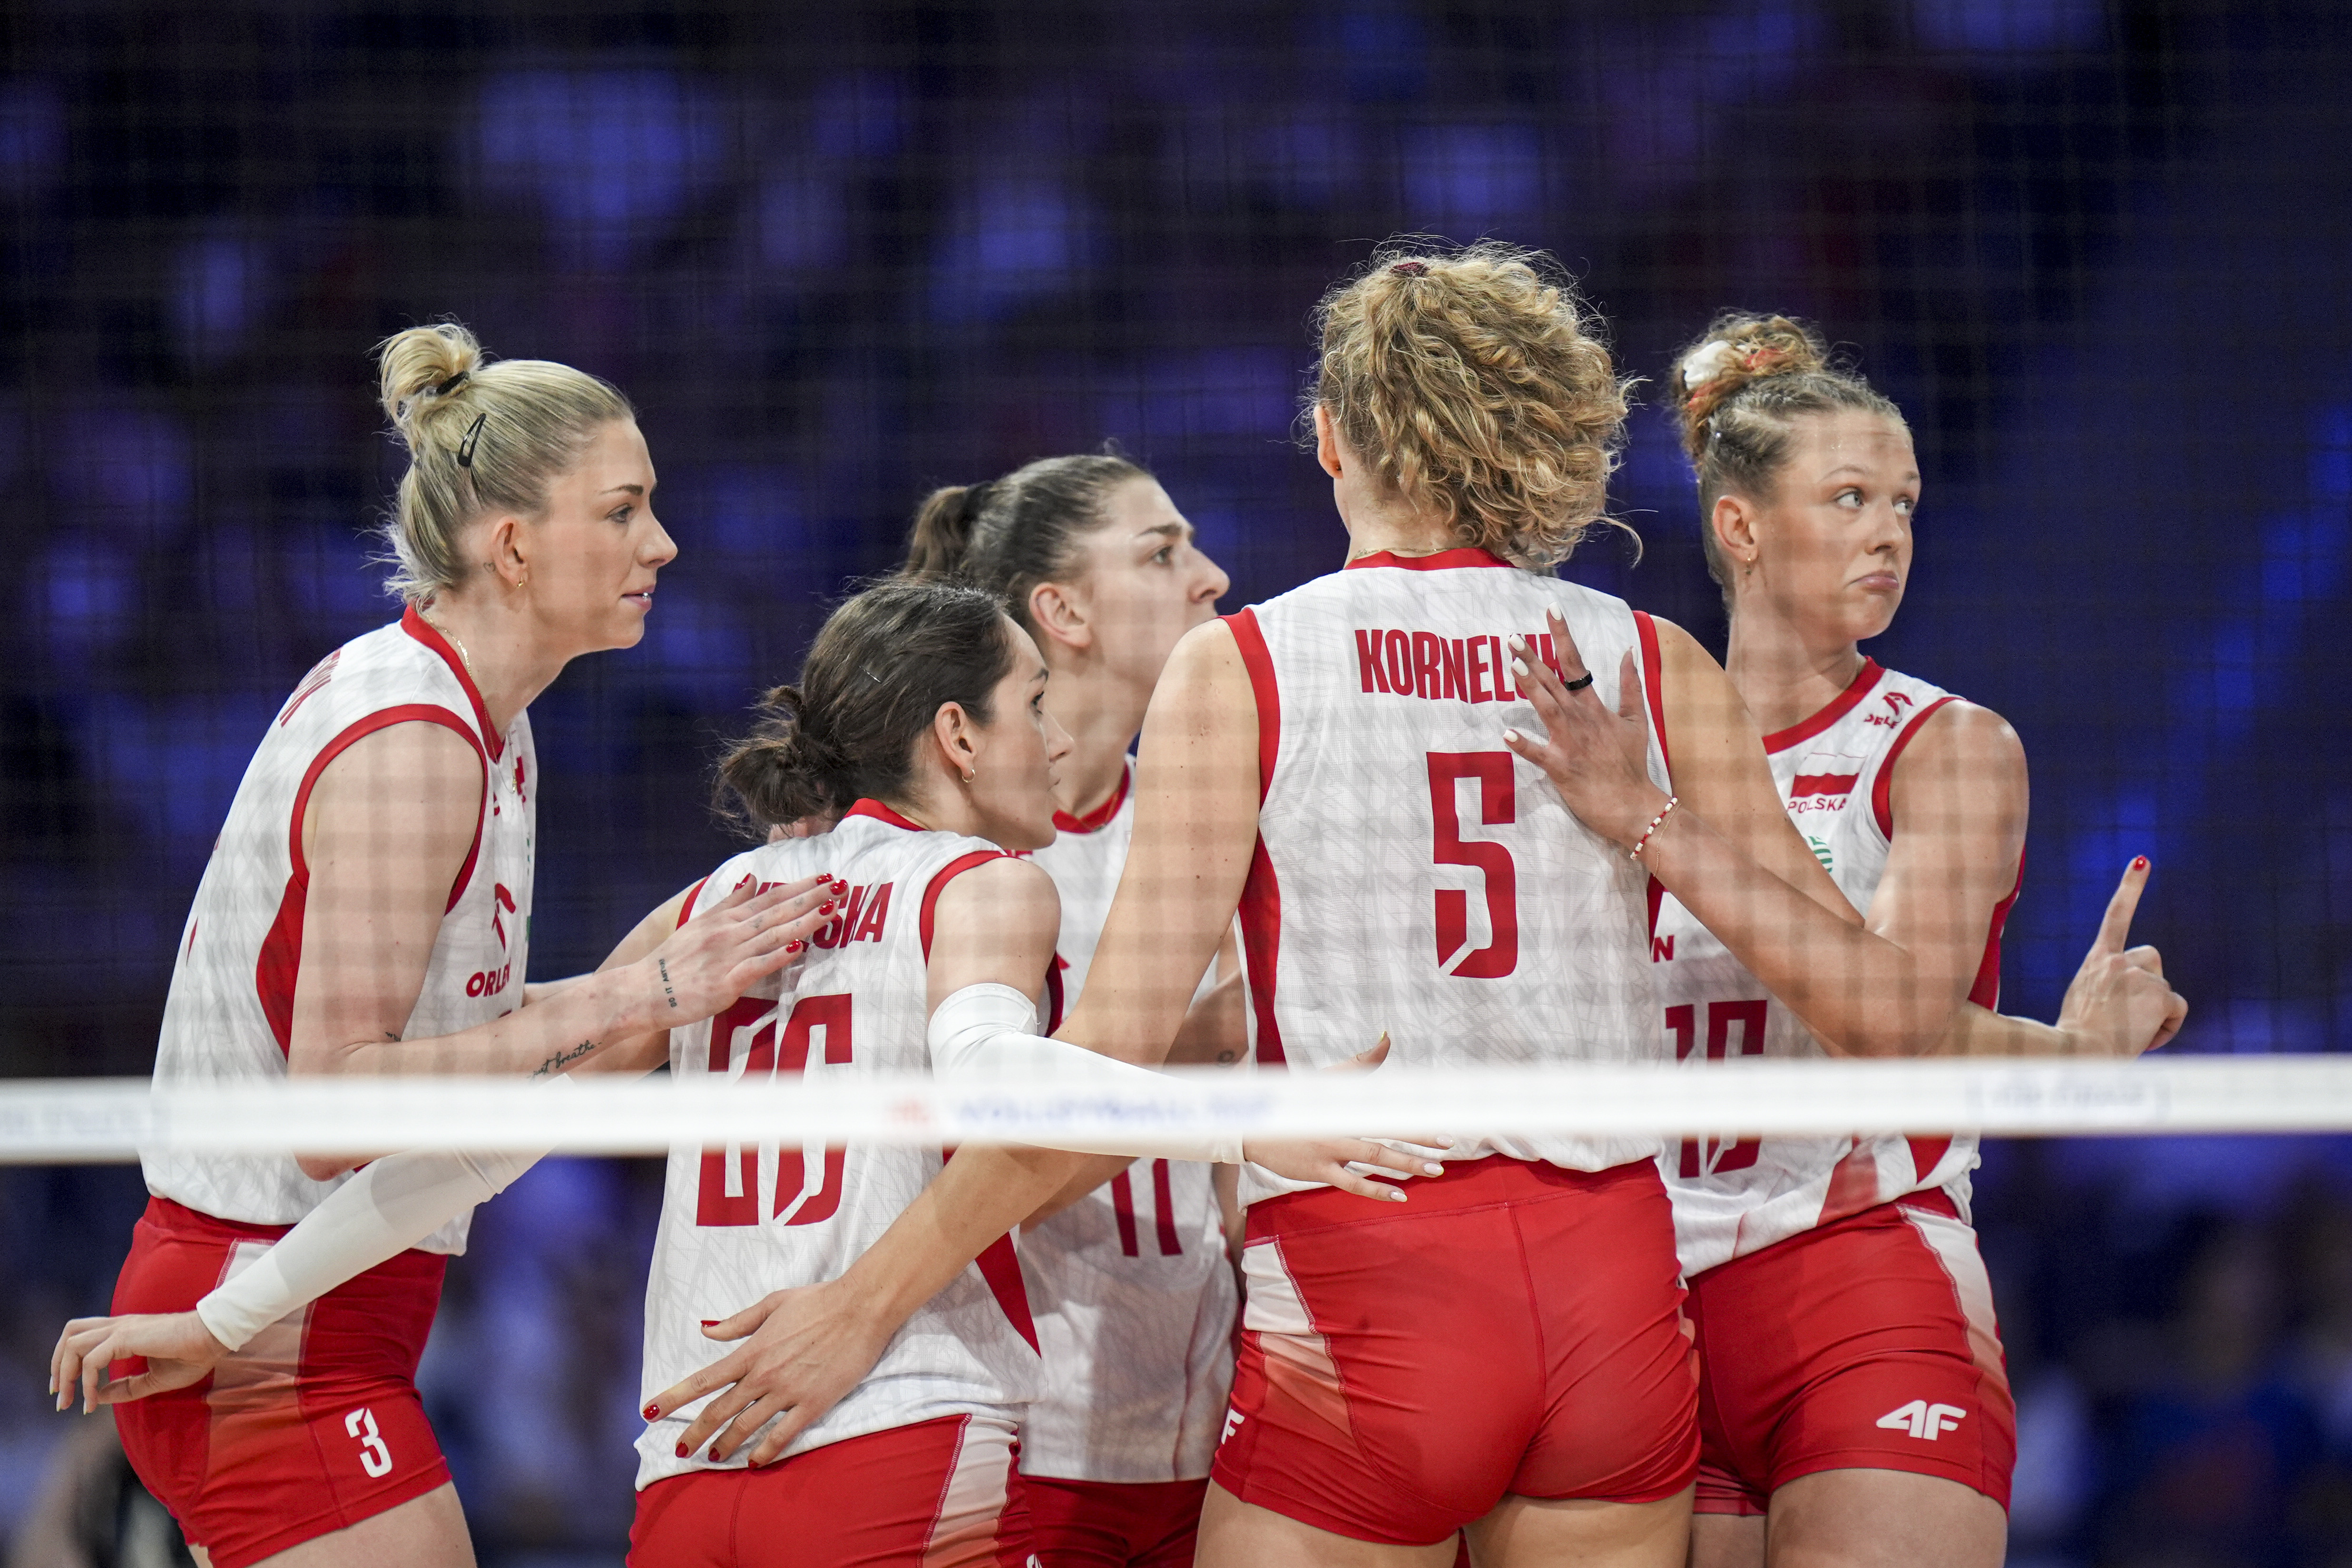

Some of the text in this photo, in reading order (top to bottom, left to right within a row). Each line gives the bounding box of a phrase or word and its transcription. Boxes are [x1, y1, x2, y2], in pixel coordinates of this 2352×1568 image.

[1786, 797, 1848, 814] POLSKA
[1425, 751, 1519, 979] 5
[344, 1407, 393, 1478] 3
[1876, 1399, 1967, 1441] 4F
